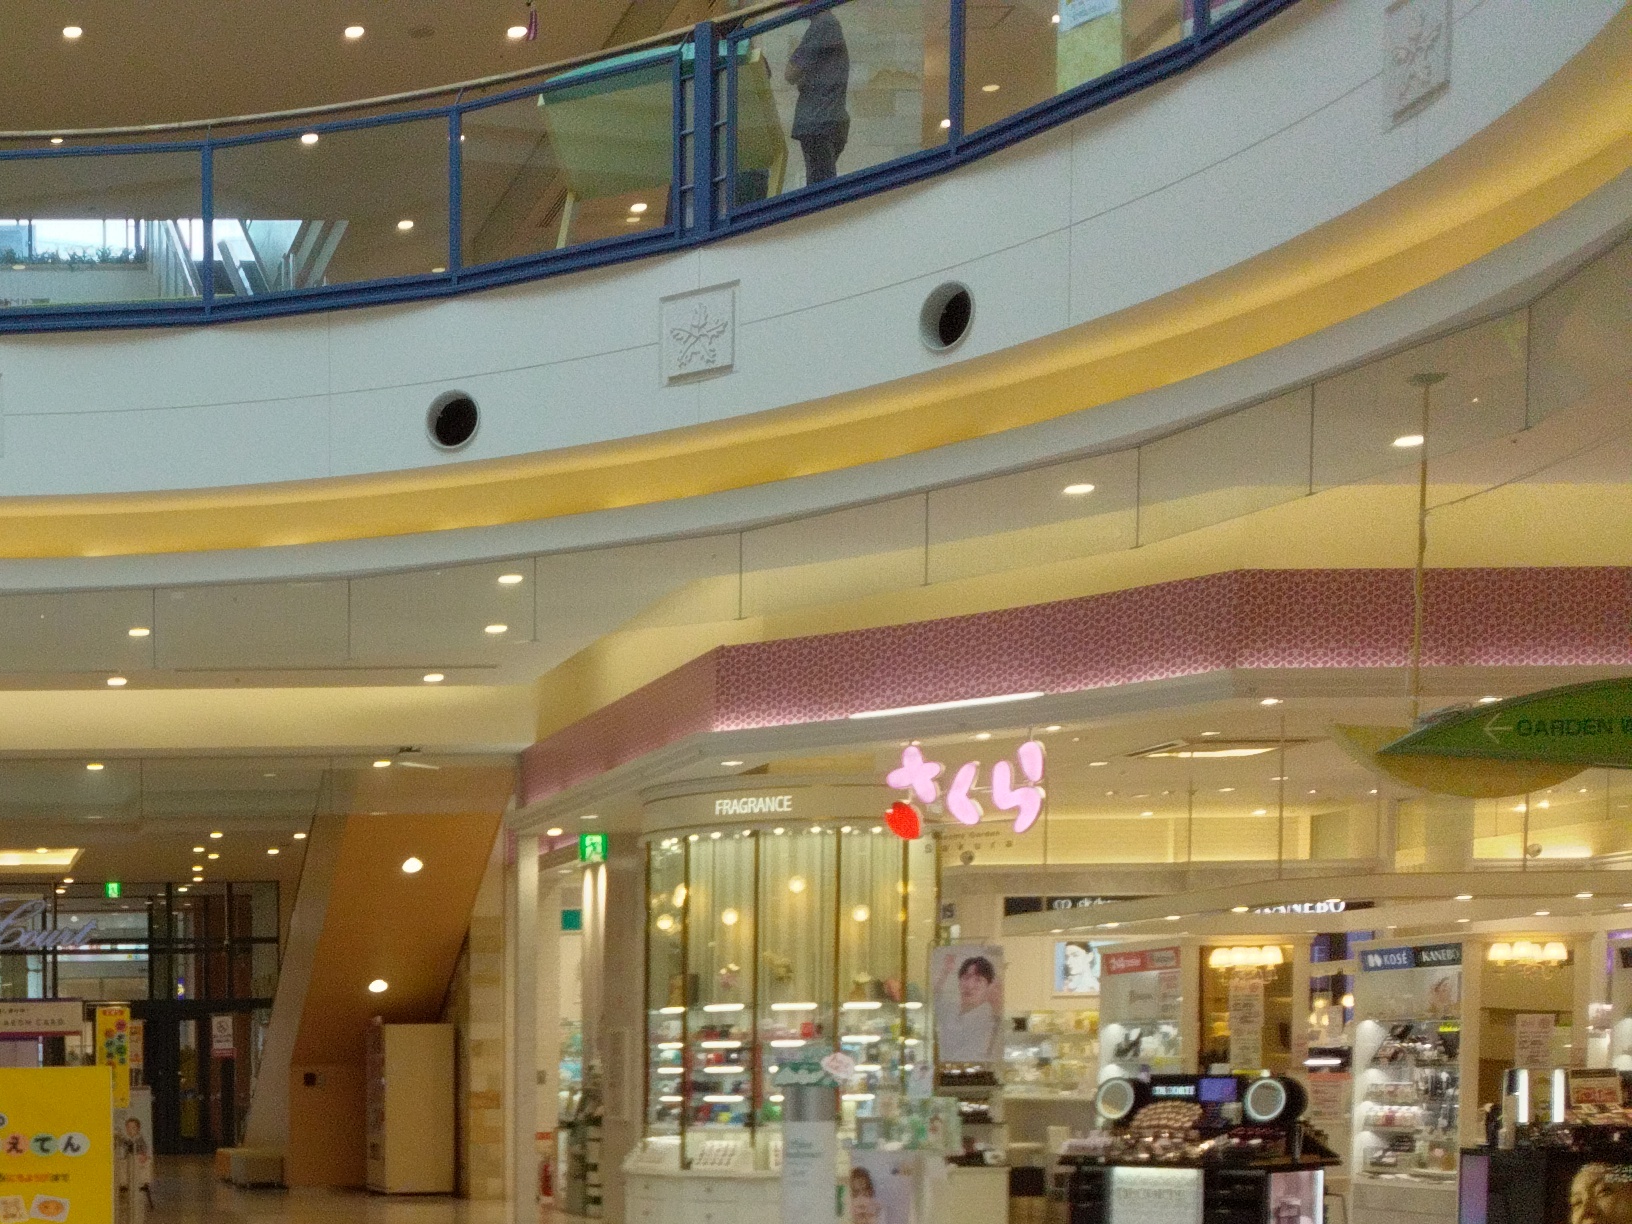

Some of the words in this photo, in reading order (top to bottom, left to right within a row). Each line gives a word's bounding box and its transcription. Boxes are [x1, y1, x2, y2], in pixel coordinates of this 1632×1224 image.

[1518, 716, 1614, 738] GARDEN
[885, 741, 1045, 840] さくら
[714, 795, 793, 815] FRAGRANCE
